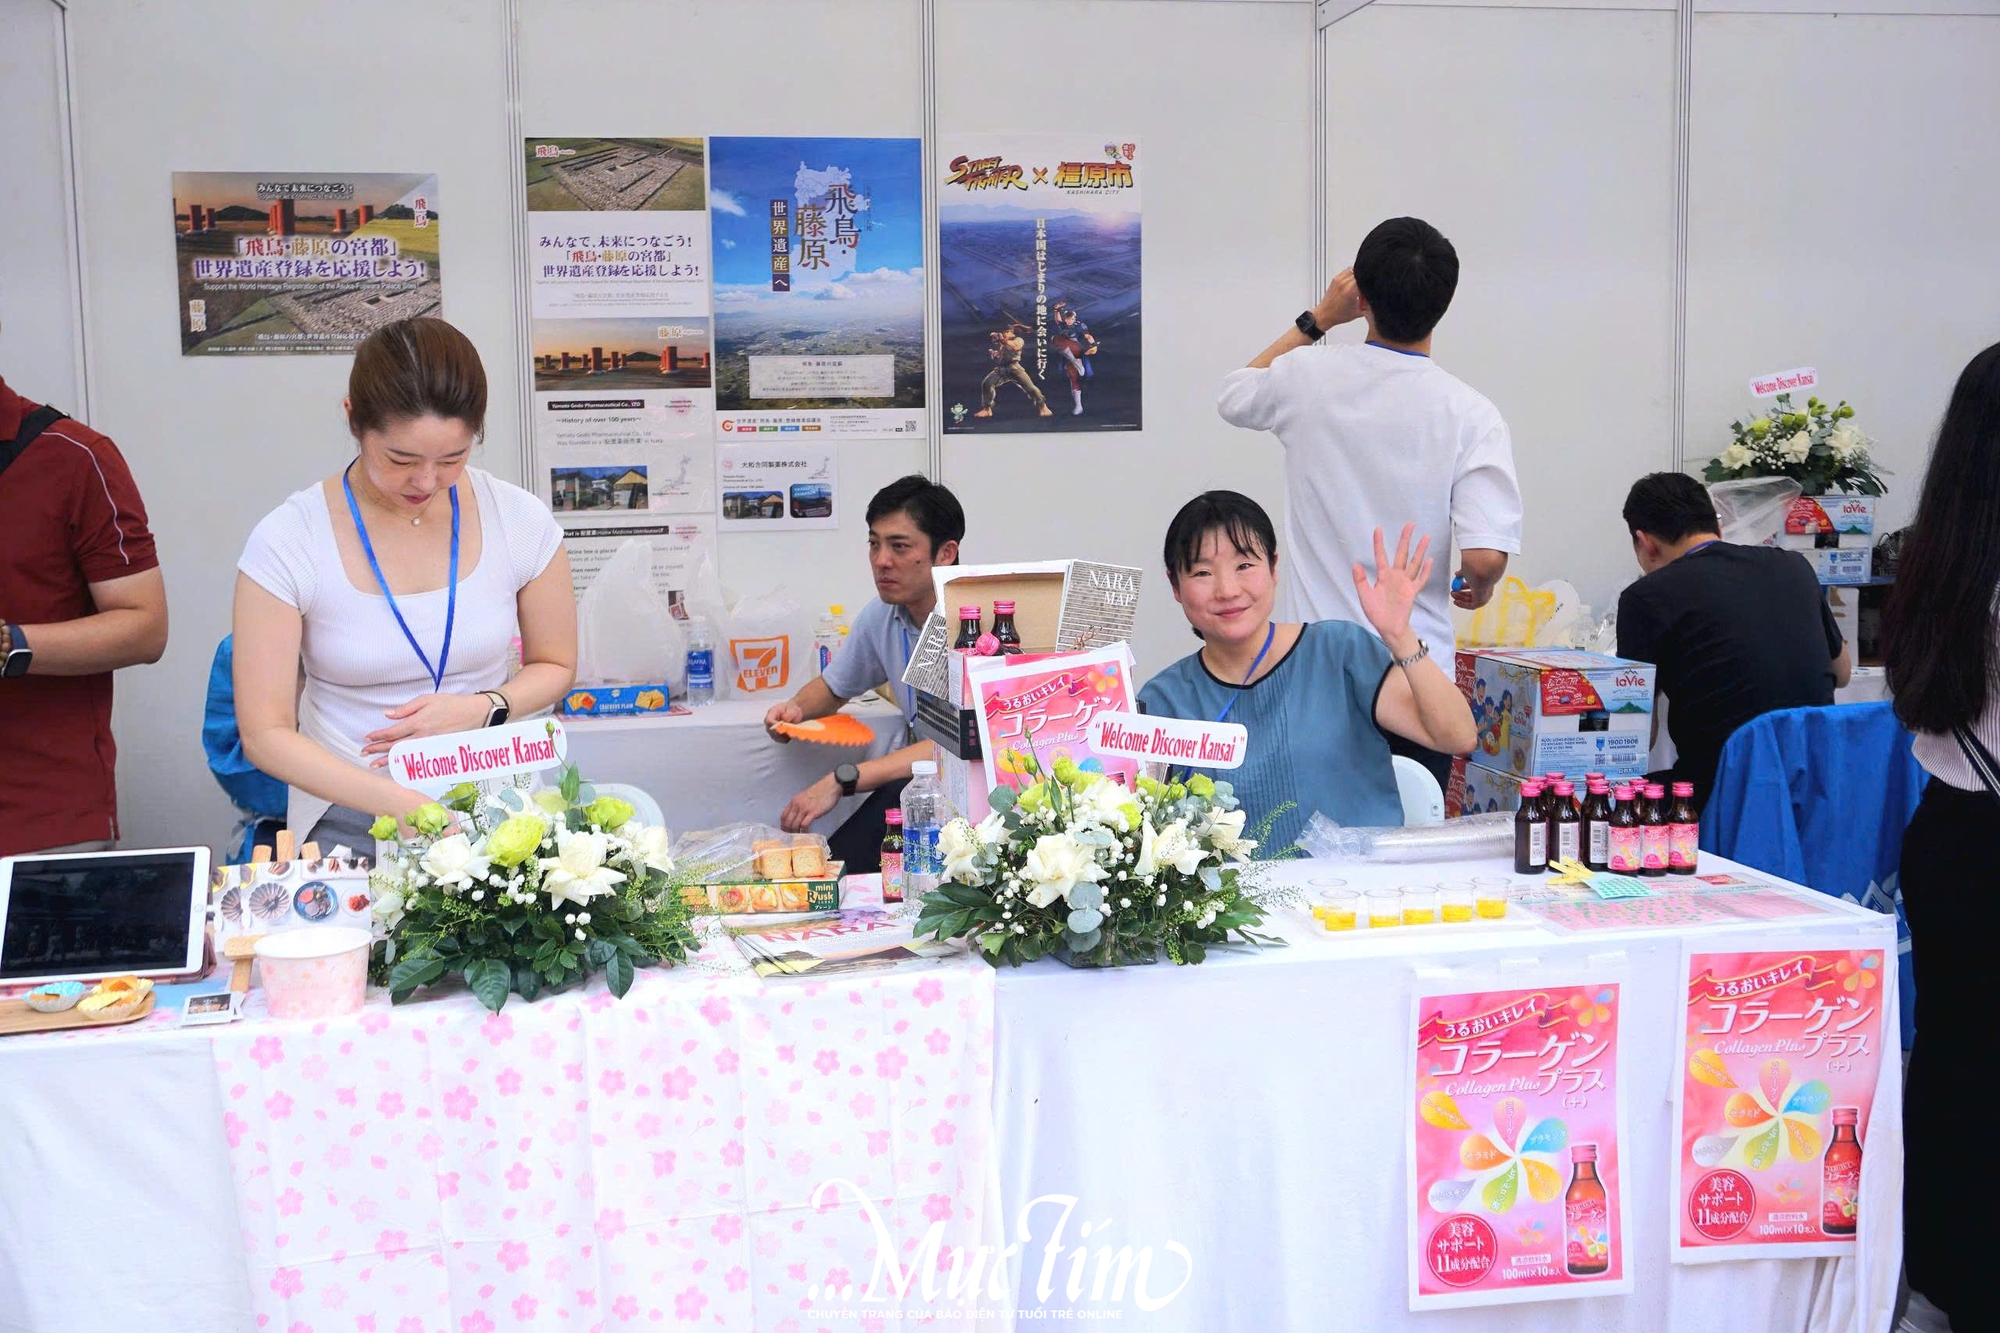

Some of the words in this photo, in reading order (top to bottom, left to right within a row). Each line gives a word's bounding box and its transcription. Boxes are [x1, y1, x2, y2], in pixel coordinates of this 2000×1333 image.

[1053, 161, 1134, 189] 橿原市
[771, 201, 789, 288] 世界遺産へ
[1088, 570, 1135, 591] NARA
[1103, 591, 1135, 607] MAP
[917, 626, 948, 672] NARA
[1615, 675, 1646, 687] laVie
[1003, 674, 1067, 710] うるおいキレイ
[1056, 731, 1080, 743] Plus
[1150, 727, 1198, 757] Discover
[458, 744, 511, 773] Discover
[815, 883, 834, 892] mini
[1714, 960, 1804, 997] うるおいキレイ
[1444, 998, 1537, 1039] うるおいキレイ
[1700, 995, 1874, 1034] コラーゲン
[1432, 1031, 1609, 1076] コラーゲン
[1714, 1041, 1775, 1057] Collagen
[1776, 1039, 1806, 1053] Plus
[1803, 1033, 1870, 1059] プラス
[1445, 1080, 1508, 1098] Collagen
[1509, 1077, 1541, 1092] Plus
[1538, 1068, 1607, 1096] プラス
[1710, 1175, 1735, 1191] 美容
[1699, 1192, 1743, 1207] サポート
[1697, 1208, 1749, 1226] 11成分配合
[1450, 1221, 1475, 1239] 美容
[1437, 1239, 1486, 1253] サポート
[1437, 1254, 1490, 1273] 11成分配合
